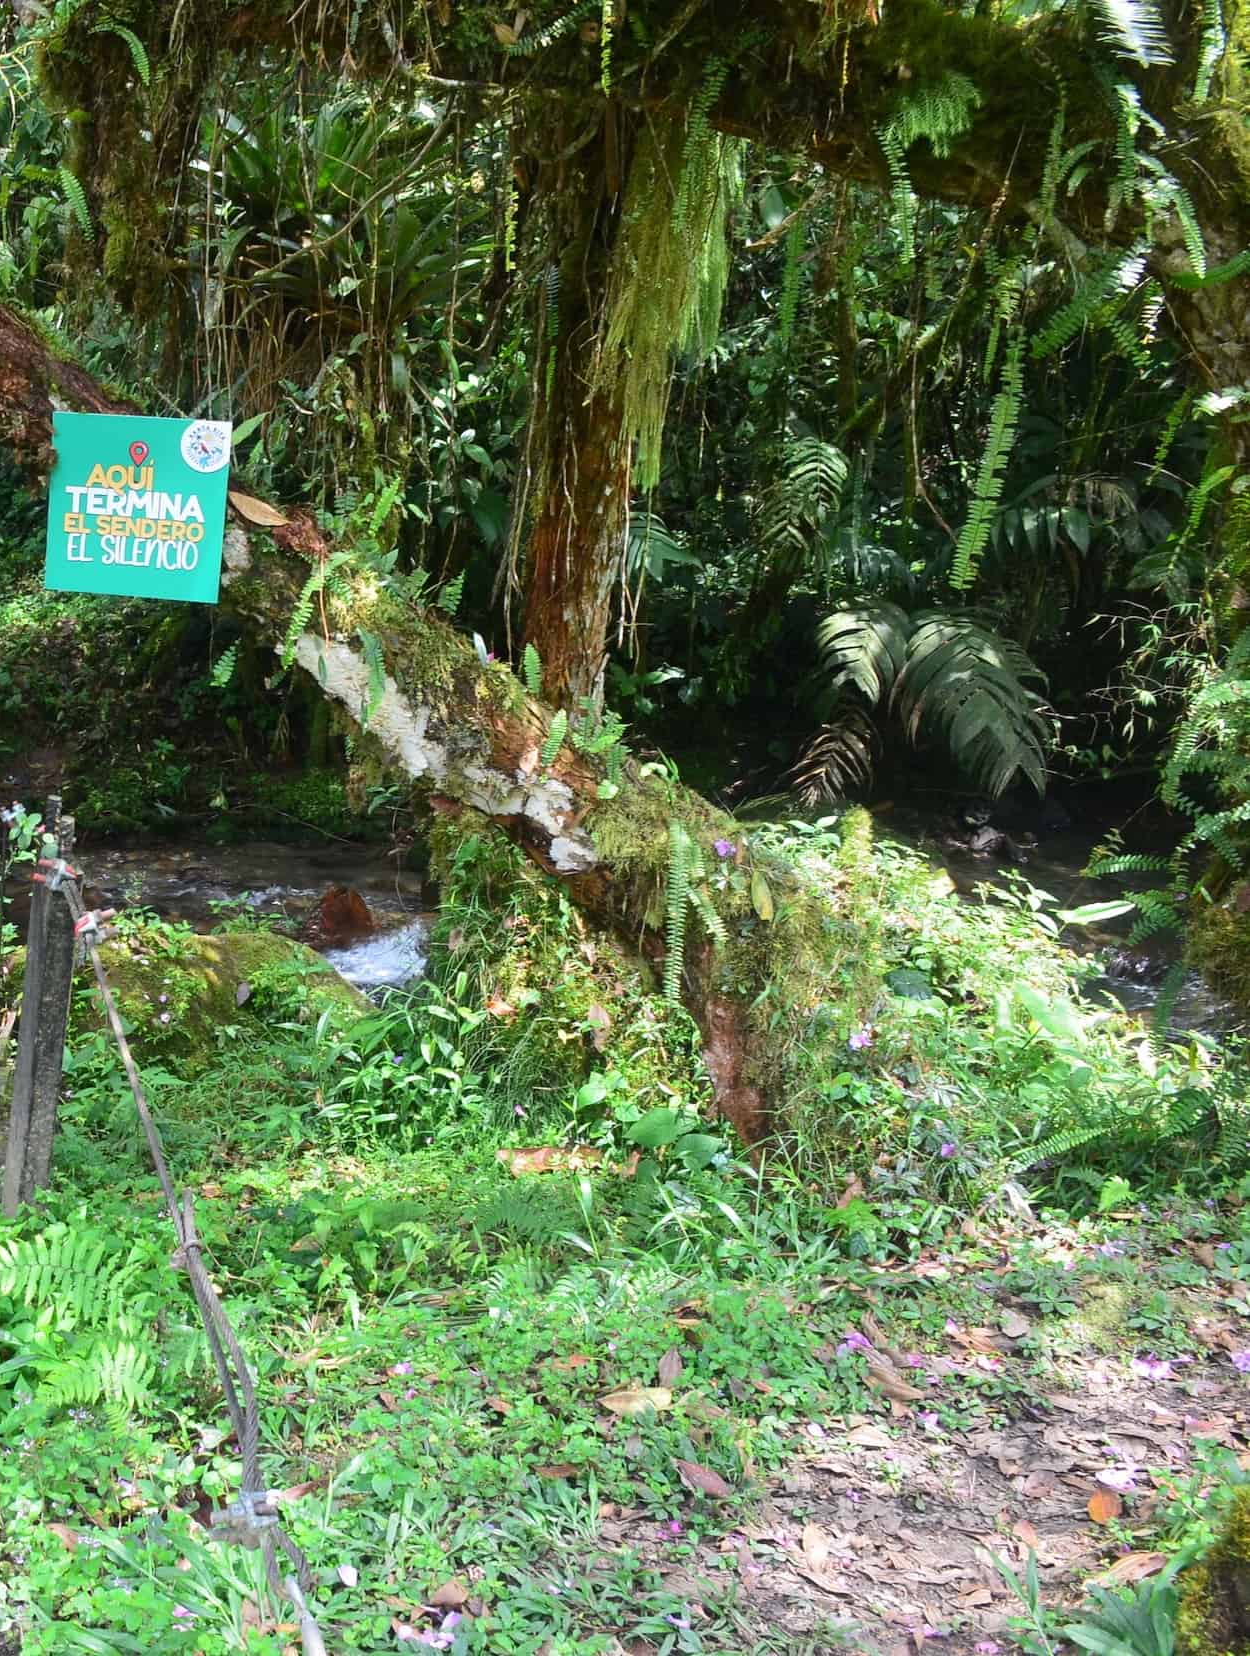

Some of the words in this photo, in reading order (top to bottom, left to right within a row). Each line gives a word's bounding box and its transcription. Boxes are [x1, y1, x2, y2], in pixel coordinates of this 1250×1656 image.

[86, 459, 155, 494] AQUÍ
[65, 486, 205, 523] TERMINA
[63, 512, 91, 534] EL
[96, 515, 205, 543] SENDERO
[67, 533, 94, 563] EL
[100, 534, 199, 571] SILENCIO
